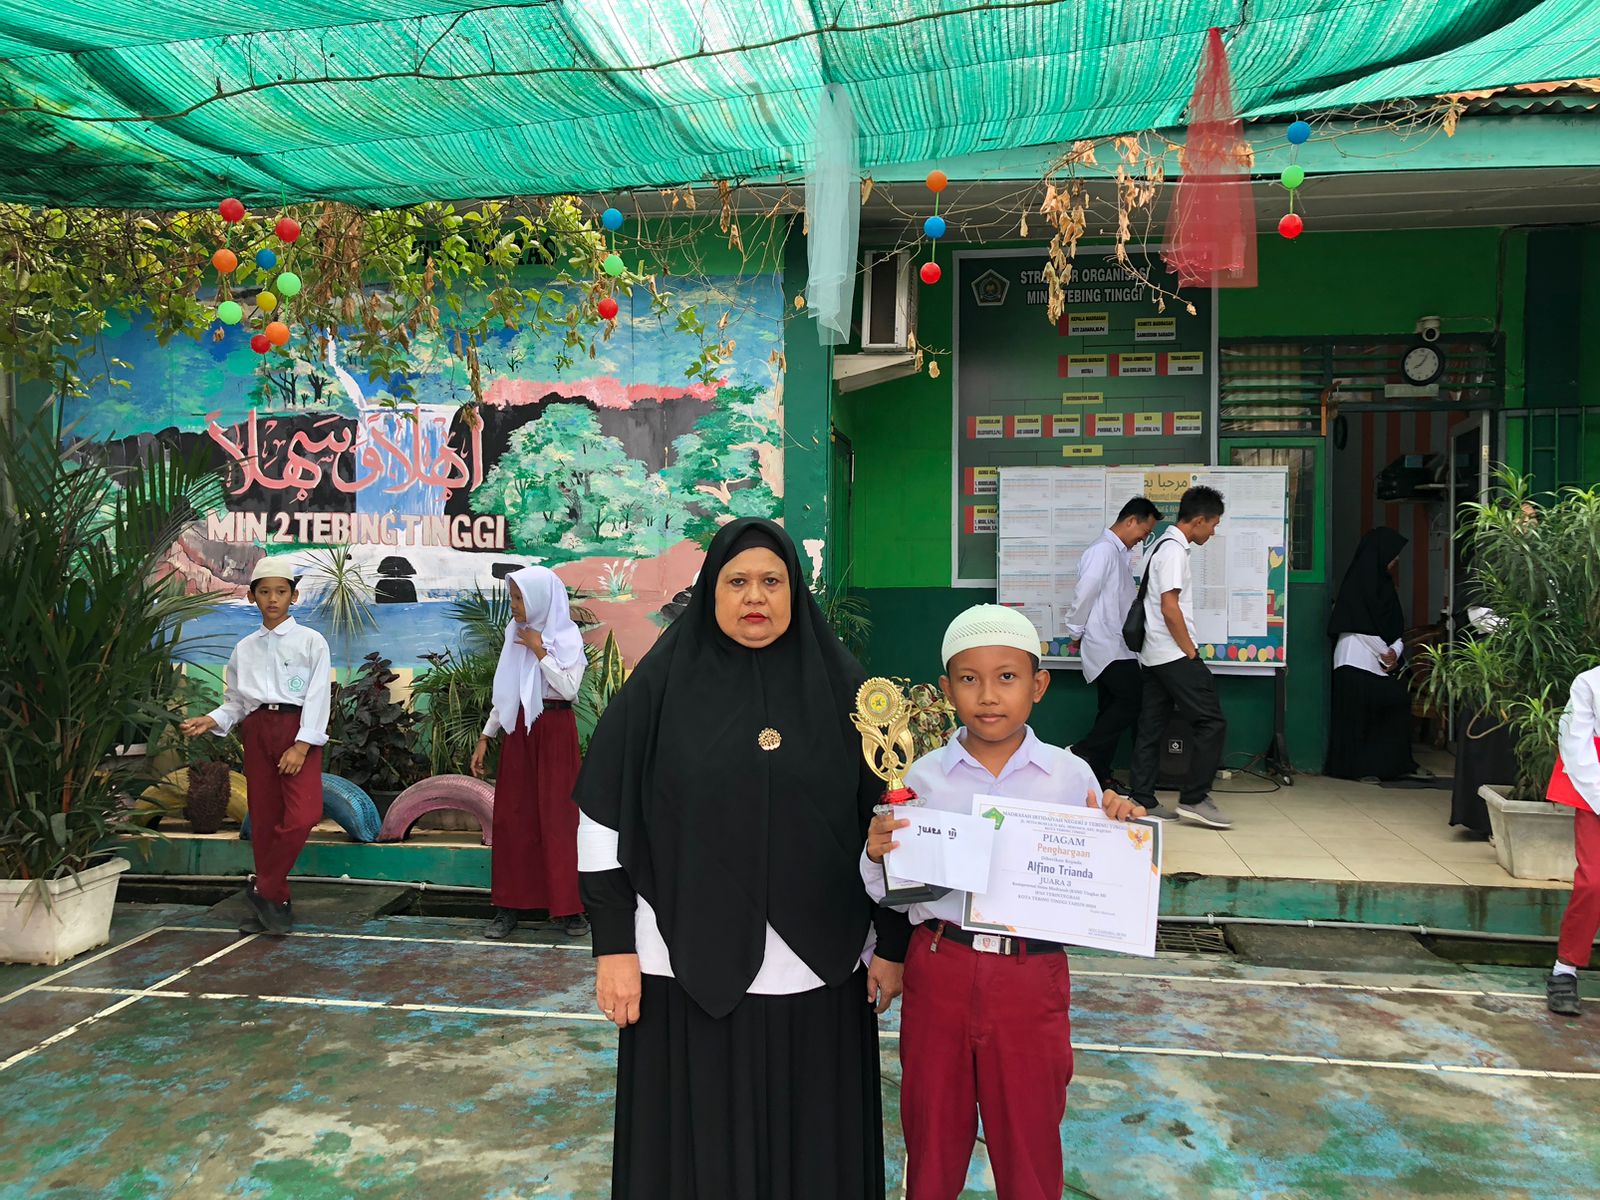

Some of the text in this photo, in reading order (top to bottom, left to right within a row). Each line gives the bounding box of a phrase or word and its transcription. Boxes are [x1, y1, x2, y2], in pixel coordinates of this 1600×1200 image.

[1020, 268, 1079, 284] STRR
[1027, 287, 1143, 305] MIN TEBING TINGGI
[206, 511, 506, 549] MIN 2 TEBING TINGGI
[1042, 833, 1085, 847] PIAGAM
[1037, 843, 1091, 859] Penghargaan
[1027, 861, 1094, 879] Alfino Trianda
[1038, 877, 1065, 886] JUARA
